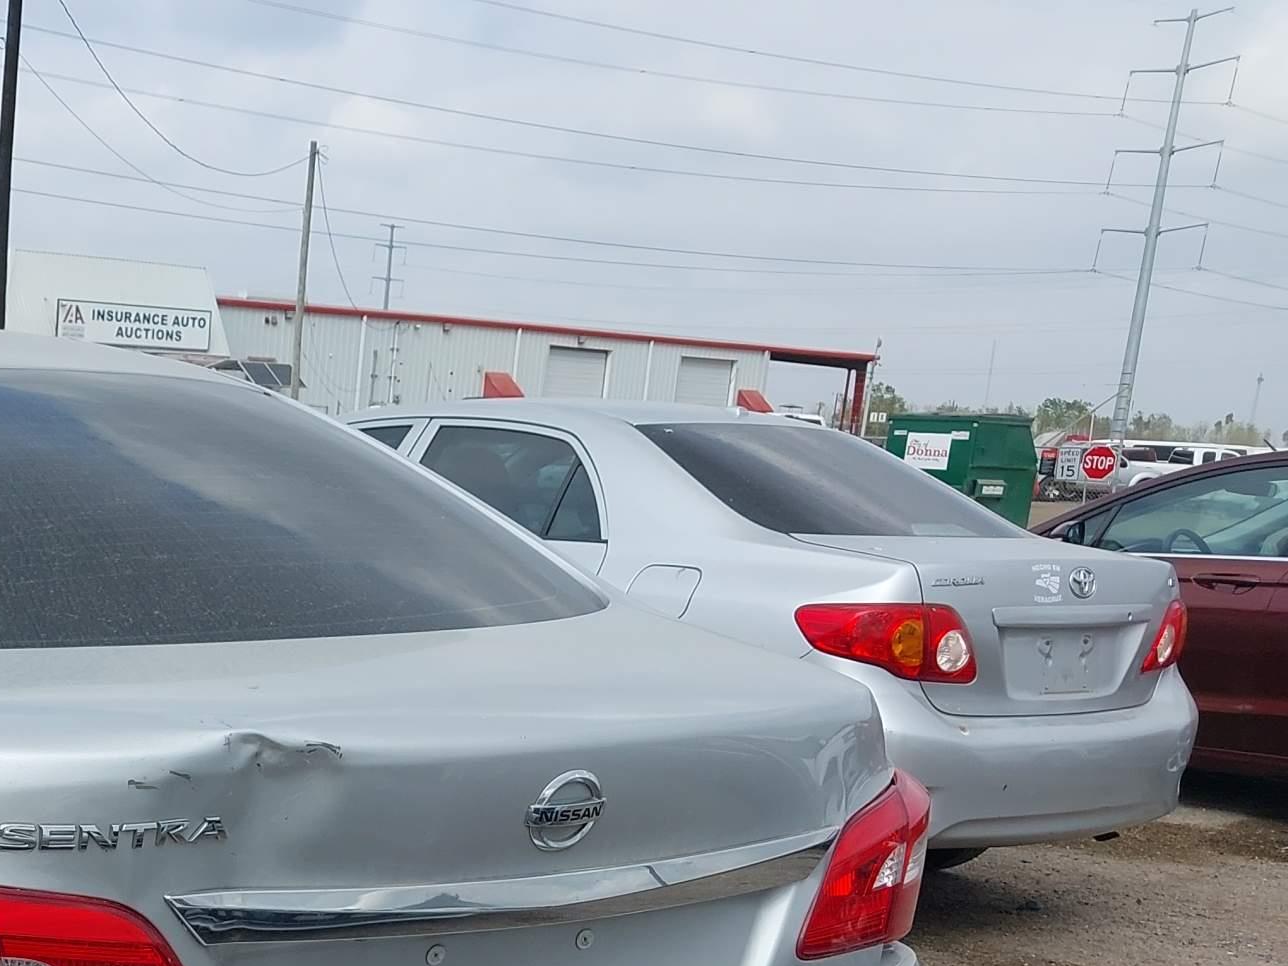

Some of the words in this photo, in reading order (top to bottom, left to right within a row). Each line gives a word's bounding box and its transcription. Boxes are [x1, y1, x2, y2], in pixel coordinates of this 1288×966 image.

[92, 308, 168, 326] INSURANCE
[172, 315, 207, 329] AUTO
[115, 326, 182, 342] AUCTIONS
[907, 445, 948, 458] Donna
[1060, 449, 1080, 457] SPEED
[1084, 455, 1114, 470] STOP
[1060, 464, 1075, 478] 15
[538, 804, 602, 823] NISSAN
